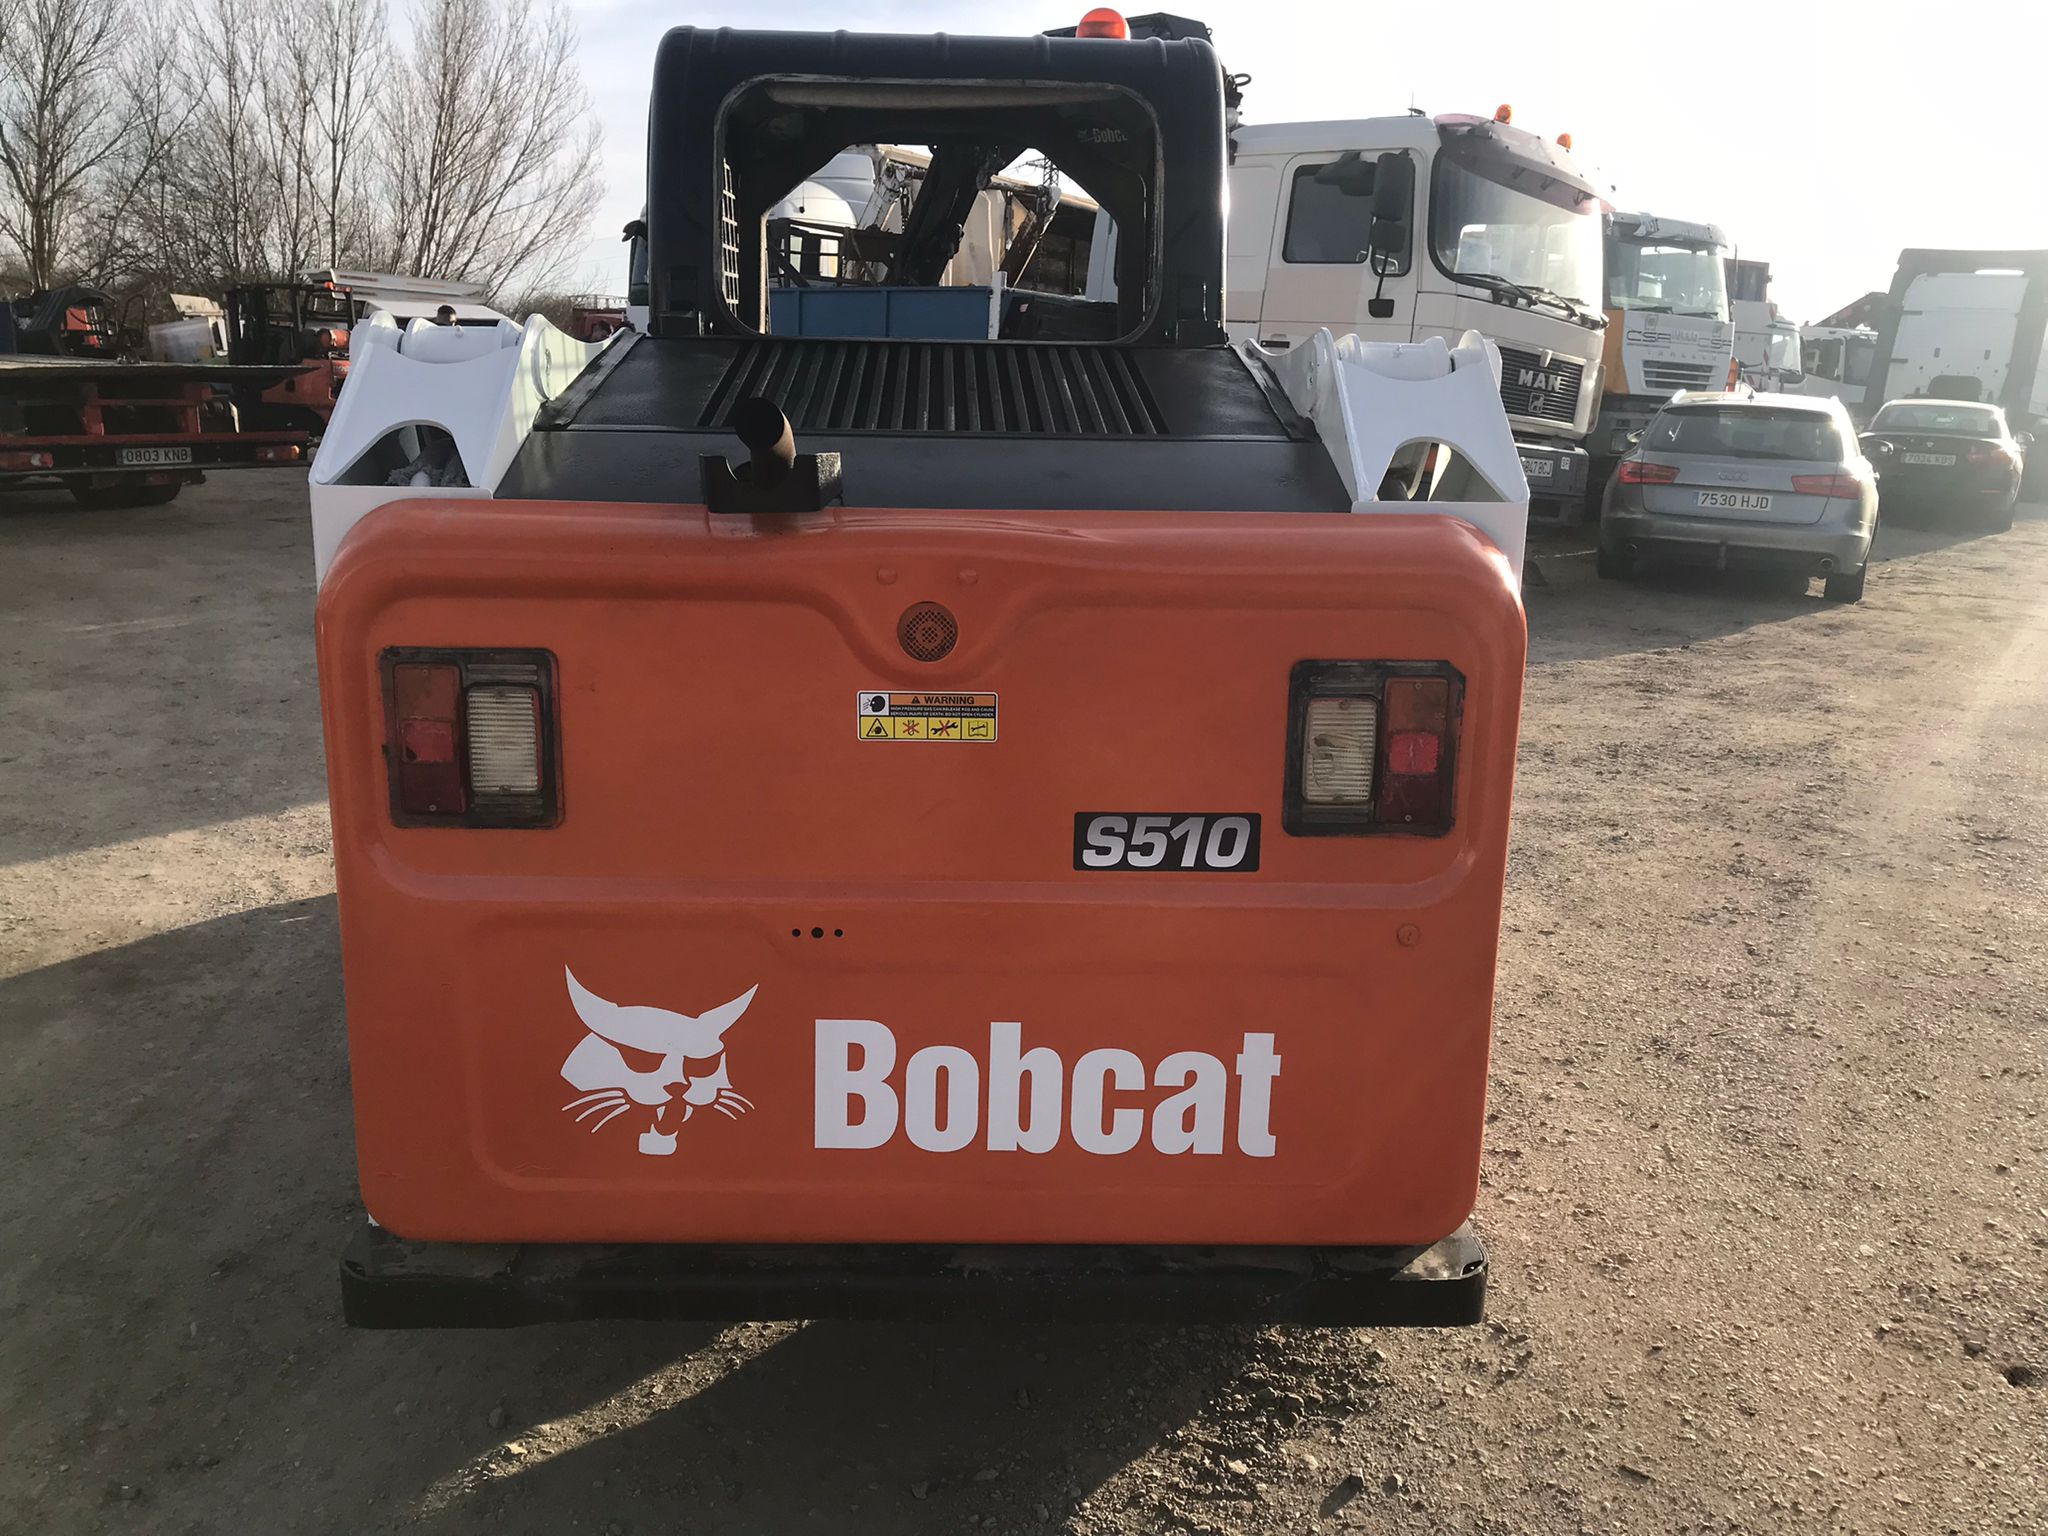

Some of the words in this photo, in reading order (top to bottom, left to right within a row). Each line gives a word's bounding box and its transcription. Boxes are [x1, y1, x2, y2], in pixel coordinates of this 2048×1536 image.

[1518, 369, 1561, 392] MAN
[126, 449, 160, 462] 0803
[163, 448, 188, 462] KNB
[1701, 492, 1737, 507] 7530
[1740, 495, 1769, 509] HJD
[923, 695, 975, 705] WARNING
[1082, 815, 1251, 868] S510
[814, 1019, 1282, 1158] Bobcat
